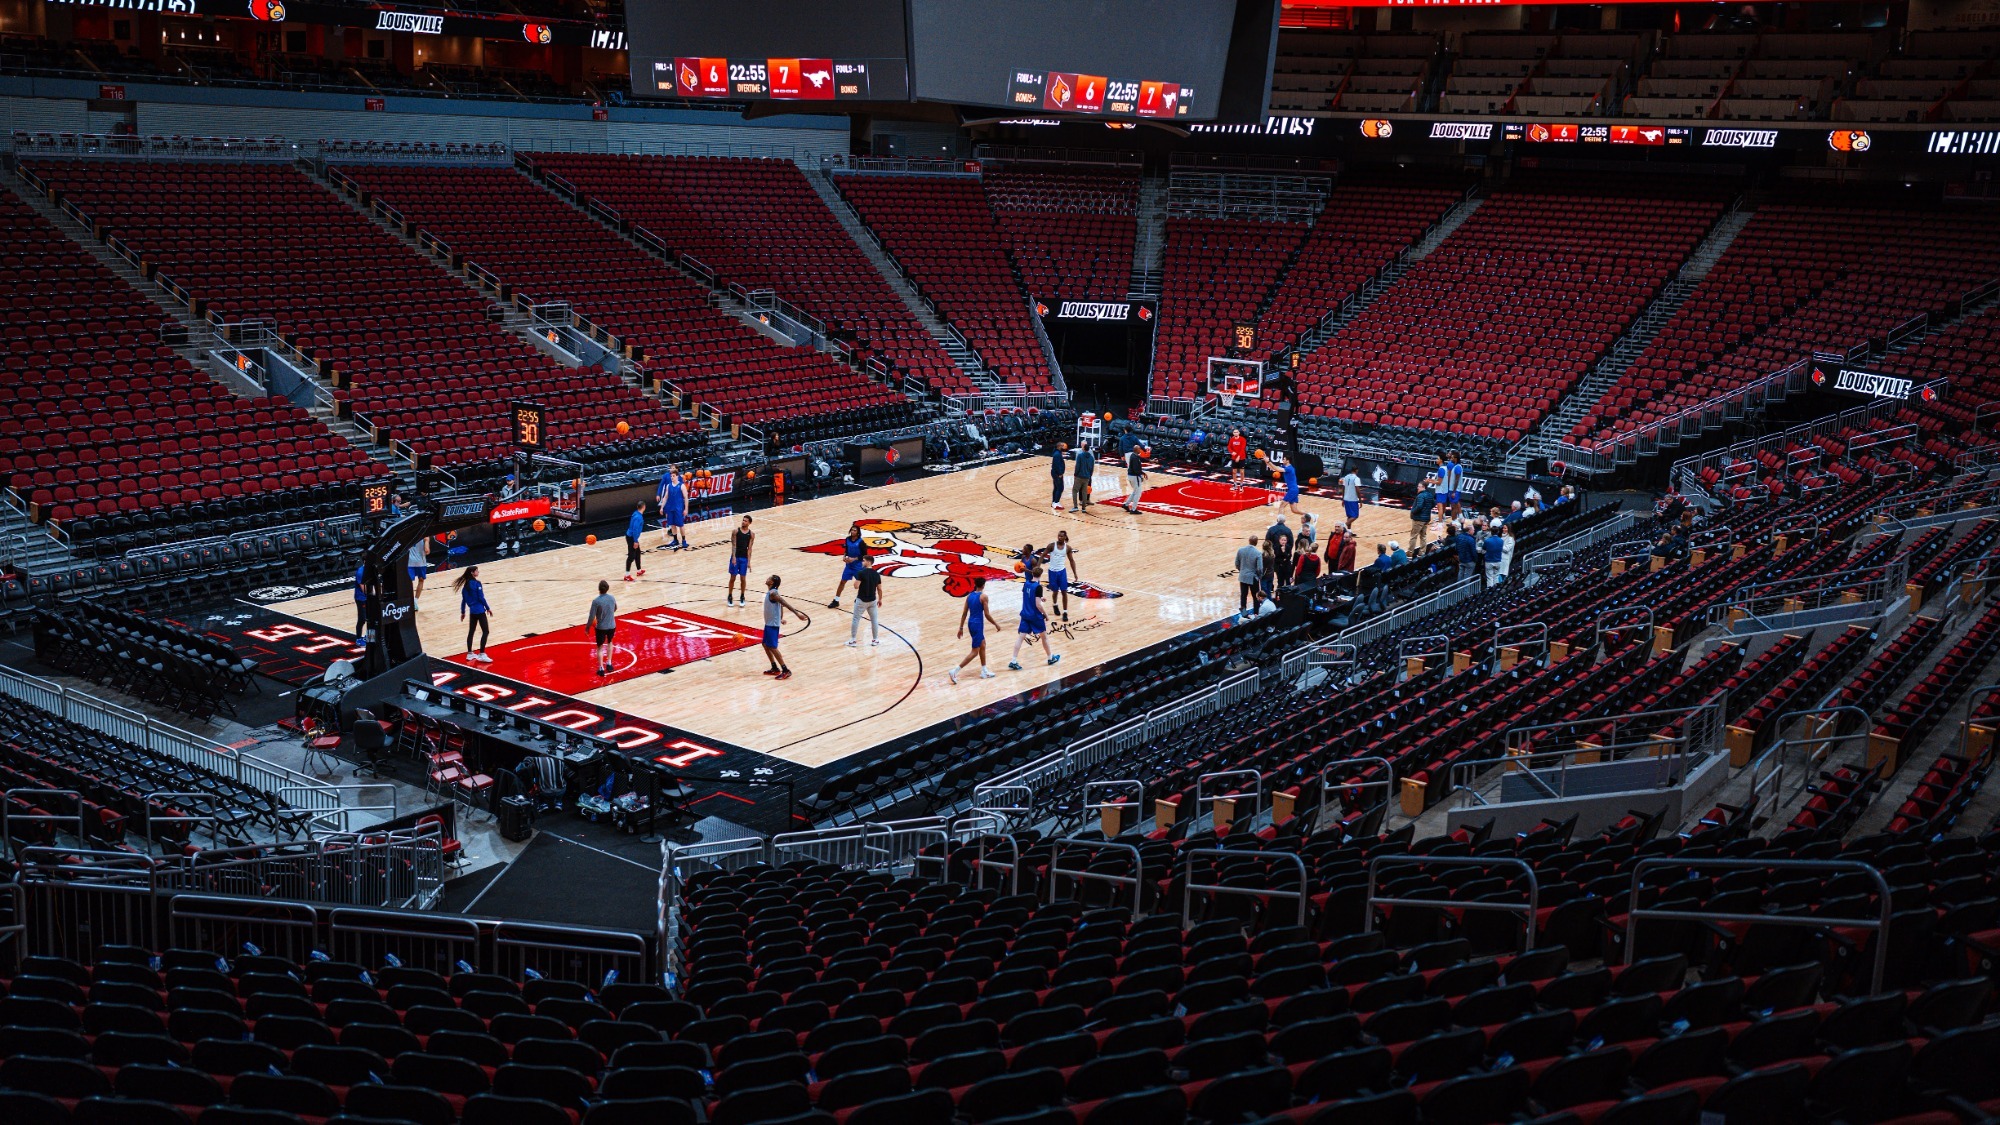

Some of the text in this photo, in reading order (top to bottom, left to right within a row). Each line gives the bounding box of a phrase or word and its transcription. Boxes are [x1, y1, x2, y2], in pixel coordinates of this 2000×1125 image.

[376, 11, 444, 35] LOUISVILLE
[709, 65, 719, 83] 6
[729, 64, 766, 81] 22:55
[779, 66, 789, 84] 7
[836, 65, 853, 73] FOULS
[1016, 73, 1034, 83] FOULS
[109, 90, 124, 99] 116
[737, 83, 761, 93] OVERTIME
[840, 85, 858, 94] BONUS
[1085, 81, 1095, 101] 6
[1107, 81, 1139, 101] 22:55
[1146, 86, 1156, 105] 7
[1015, 92, 1037, 103] BONUS+
[373, 103, 384, 111] 117
[1430, 122, 1493, 140] LOUISVILLE
[1560, 126, 1568, 137] 6
[1580, 127, 1608, 136] 22:55
[1620, 128, 1629, 138] 7
[1702, 129, 1779, 148] LOUISVILLE
[1057, 302, 1131, 321] LOUISVILLE
[1236, 326, 1254, 336] 22:55
[1237, 335, 1251, 348] 30
[1834, 369, 1913, 400] LOUISVILLE
[517, 409, 539, 423] 22:55
[520, 422, 538, 445] 30
[364, 486, 388, 498] 22:55
[370, 497, 383, 512] 30
[443, 501, 485, 518] LOUISVILLE
[382, 602, 411, 621] Kroger
